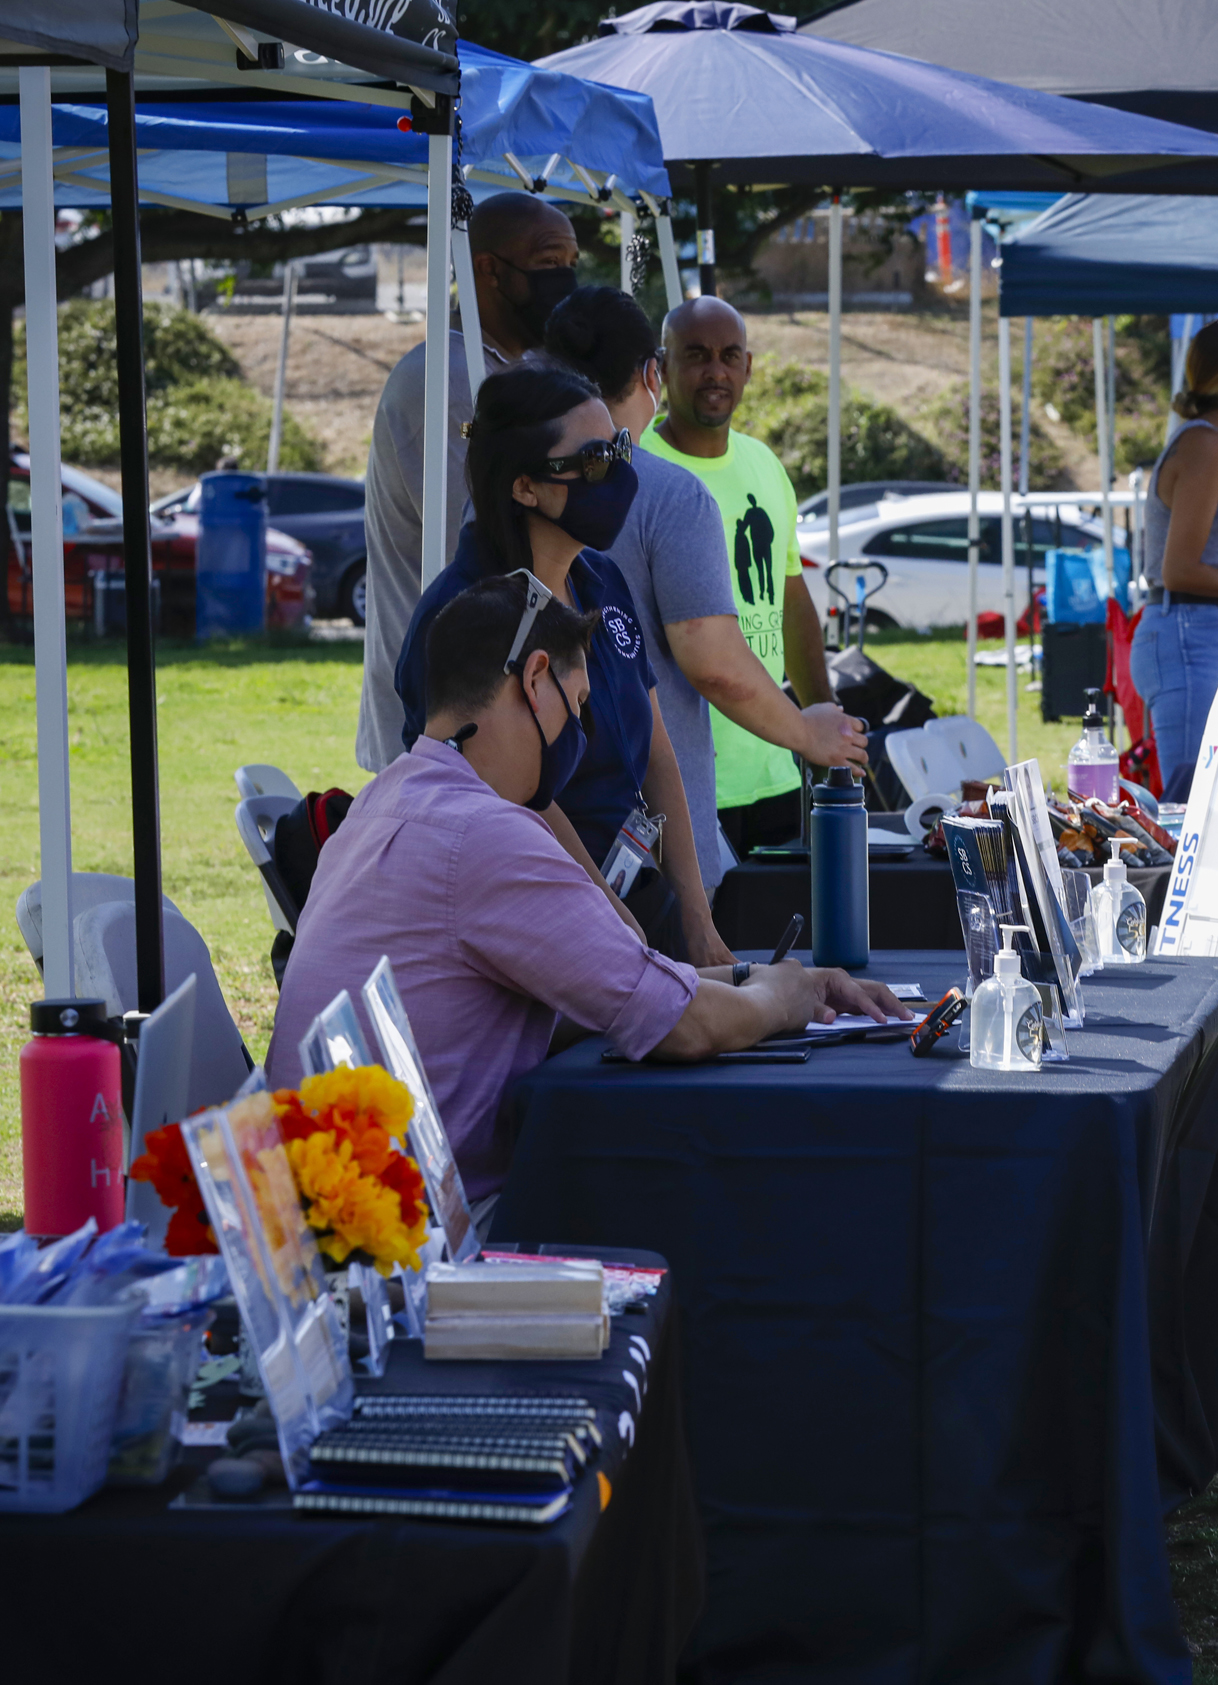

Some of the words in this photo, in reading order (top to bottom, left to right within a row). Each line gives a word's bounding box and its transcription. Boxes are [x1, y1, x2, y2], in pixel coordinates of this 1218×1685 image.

[741, 613, 763, 631] ING
[745, 633, 784, 658] TUR
[1159, 833, 1199, 952] TNESS
